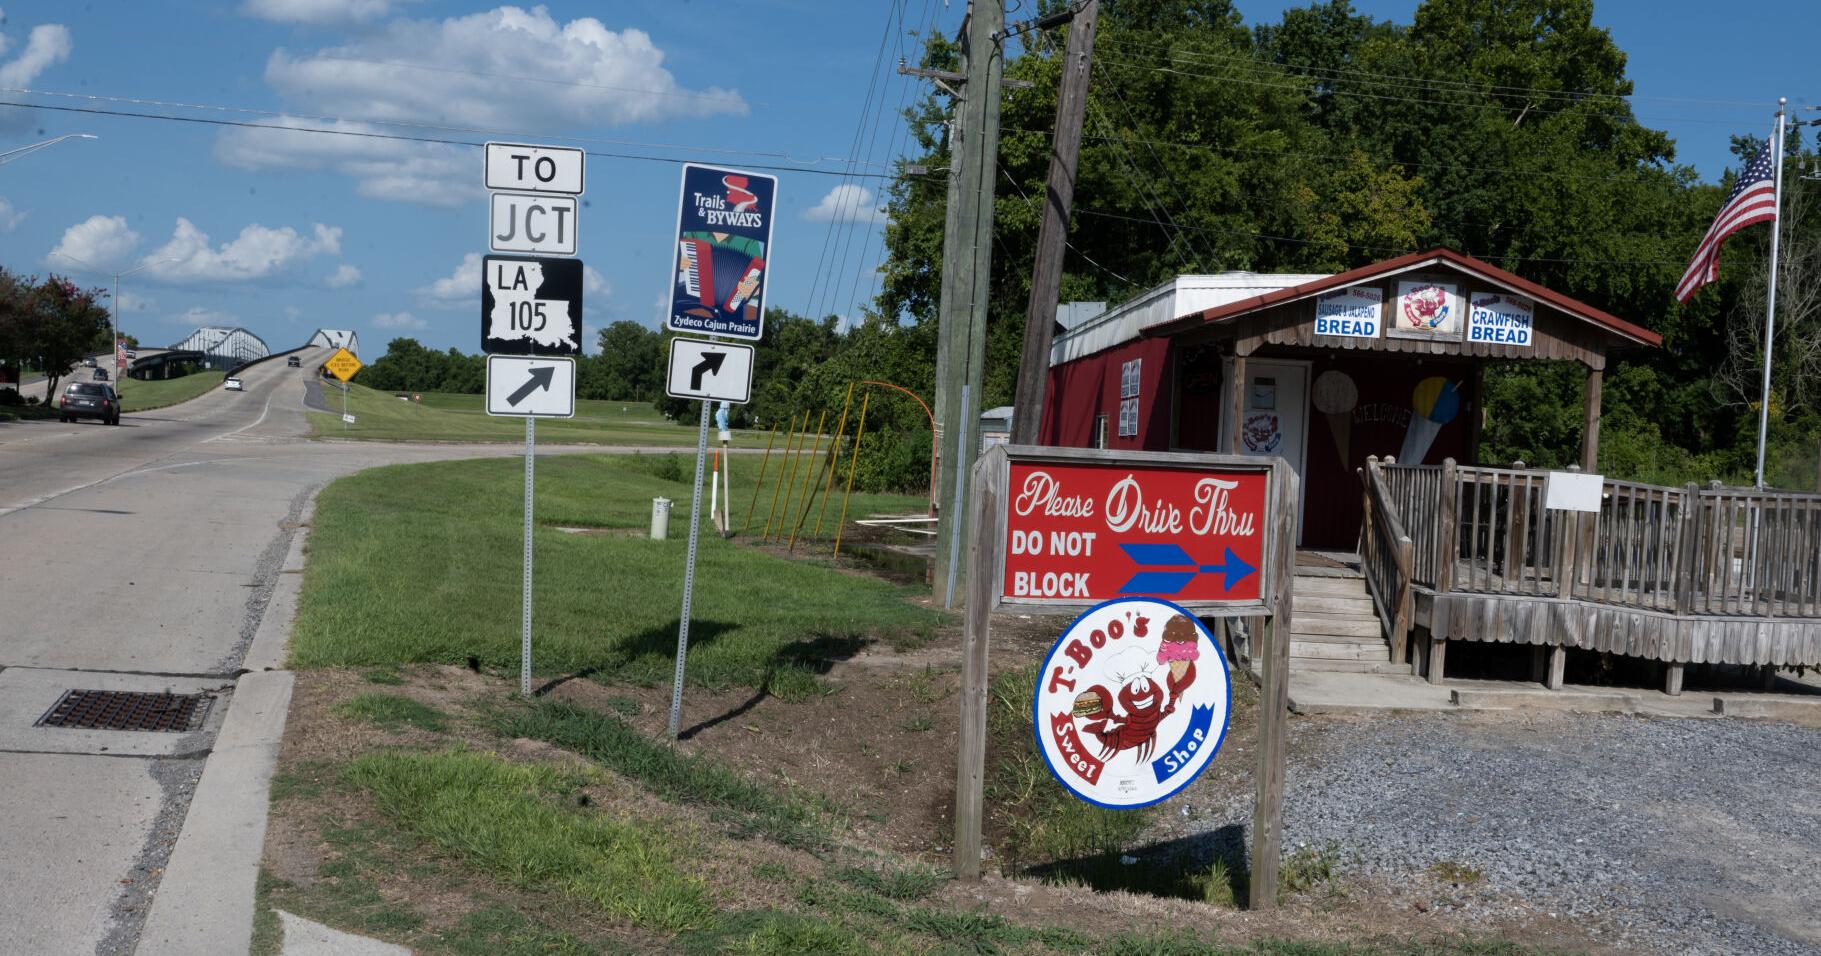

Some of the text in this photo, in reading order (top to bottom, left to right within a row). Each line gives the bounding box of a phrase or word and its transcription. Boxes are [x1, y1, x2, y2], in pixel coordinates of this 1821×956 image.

[511, 154, 557, 183] TO
[694, 192, 726, 210] Trails
[496, 203, 571, 244] JCT
[698, 207, 763, 228] & BYWAYS
[497, 264, 529, 292] LA
[509, 300, 547, 332] 105
[1317, 303, 1343, 317] SAUSAGE
[1472, 310, 1530, 329] CRAWFISH
[674, 314, 756, 334] Zydeco Cajun Prairie
[1316, 319, 1375, 336] BREAD
[1471, 326, 1528, 344] BREAD
[1015, 471, 1094, 518] Please
[1105, 473, 1255, 537] Drive Thru
[1011, 530, 1097, 557] DO NOT
[1014, 571, 1091, 597] BLOCK
[1056, 722, 1097, 779] Sweet
[1163, 727, 1206, 774] Shop
